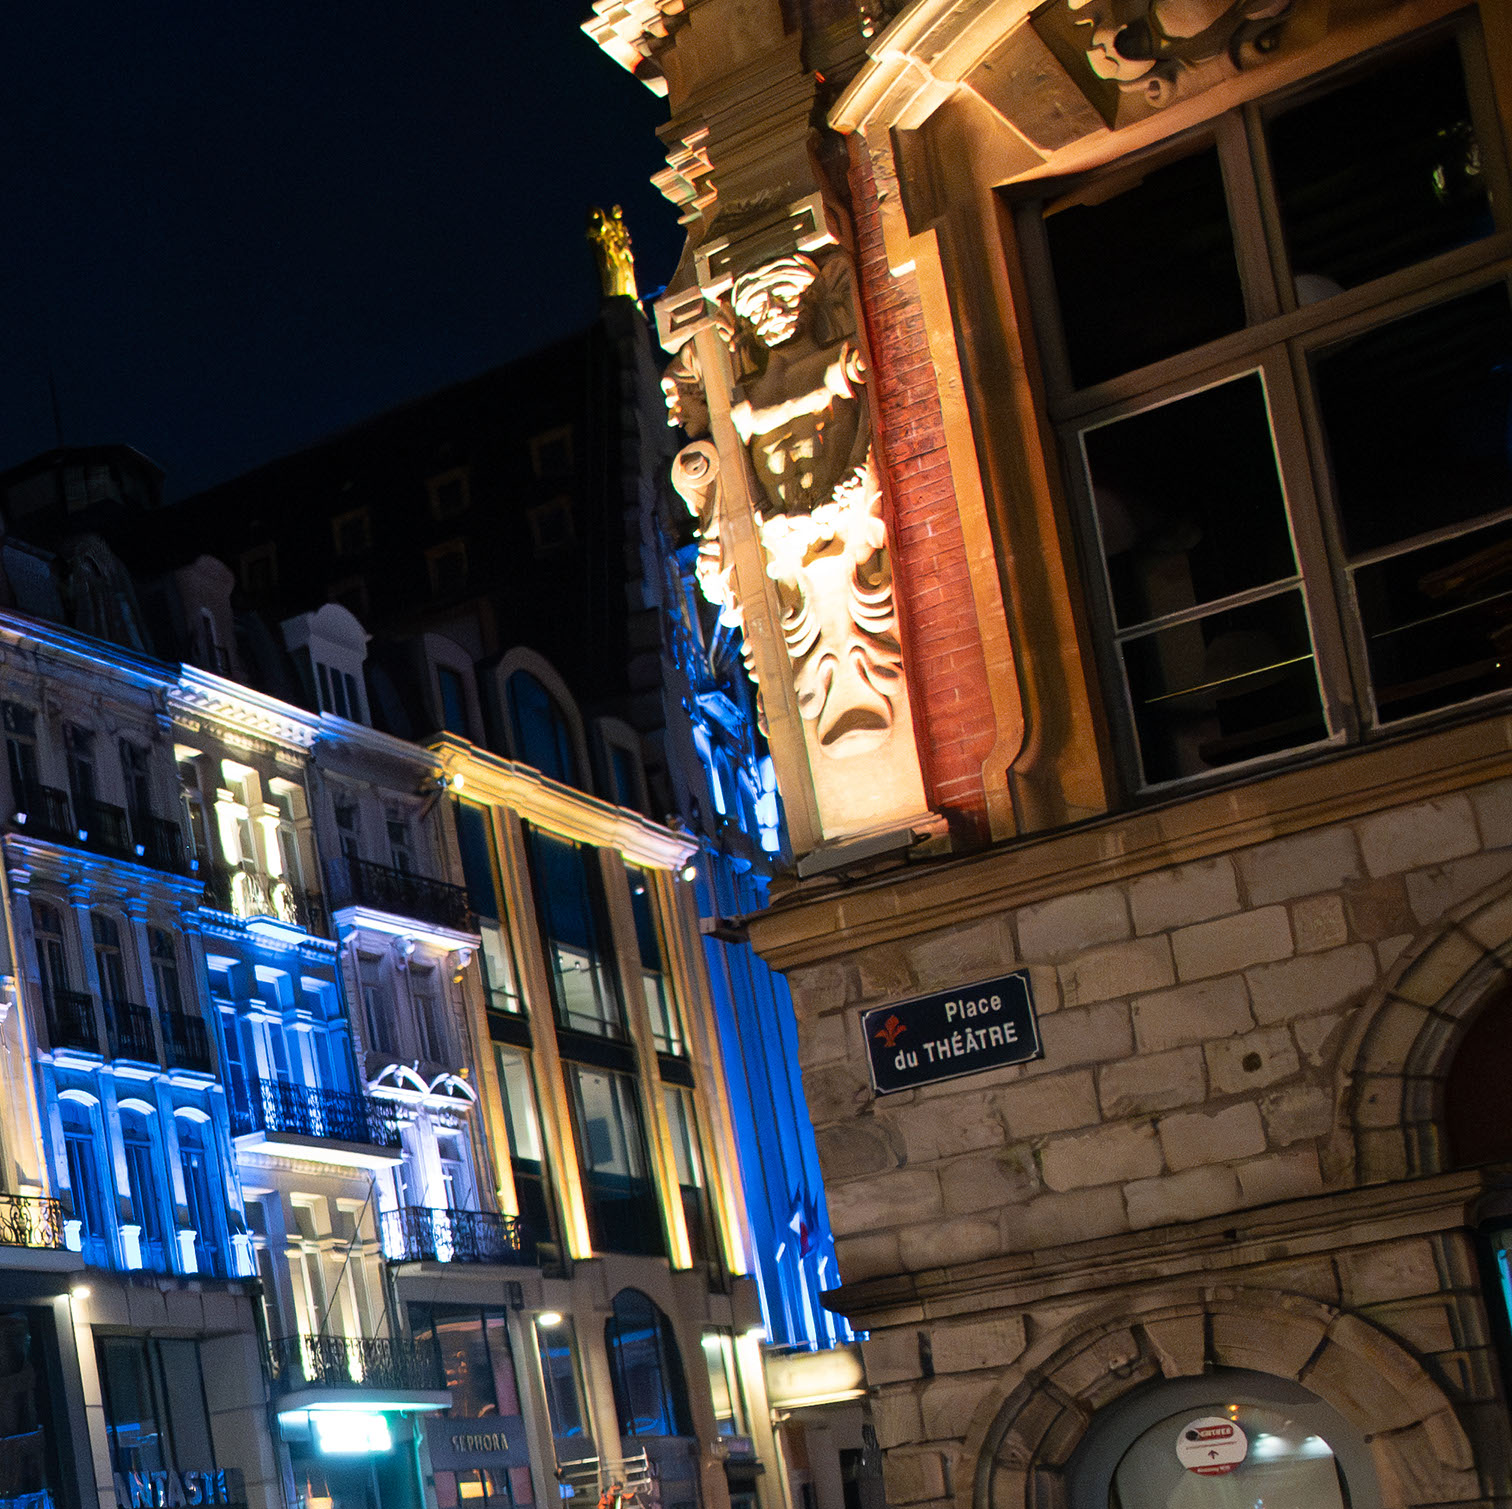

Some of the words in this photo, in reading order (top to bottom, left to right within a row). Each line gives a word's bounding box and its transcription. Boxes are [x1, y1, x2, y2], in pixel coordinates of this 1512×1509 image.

[944, 995, 1002, 1023] Place
[895, 1050, 919, 1070] du
[923, 1021, 1018, 1063] THÉÂTRE
[451, 1432, 509, 1453] SEPHORA
